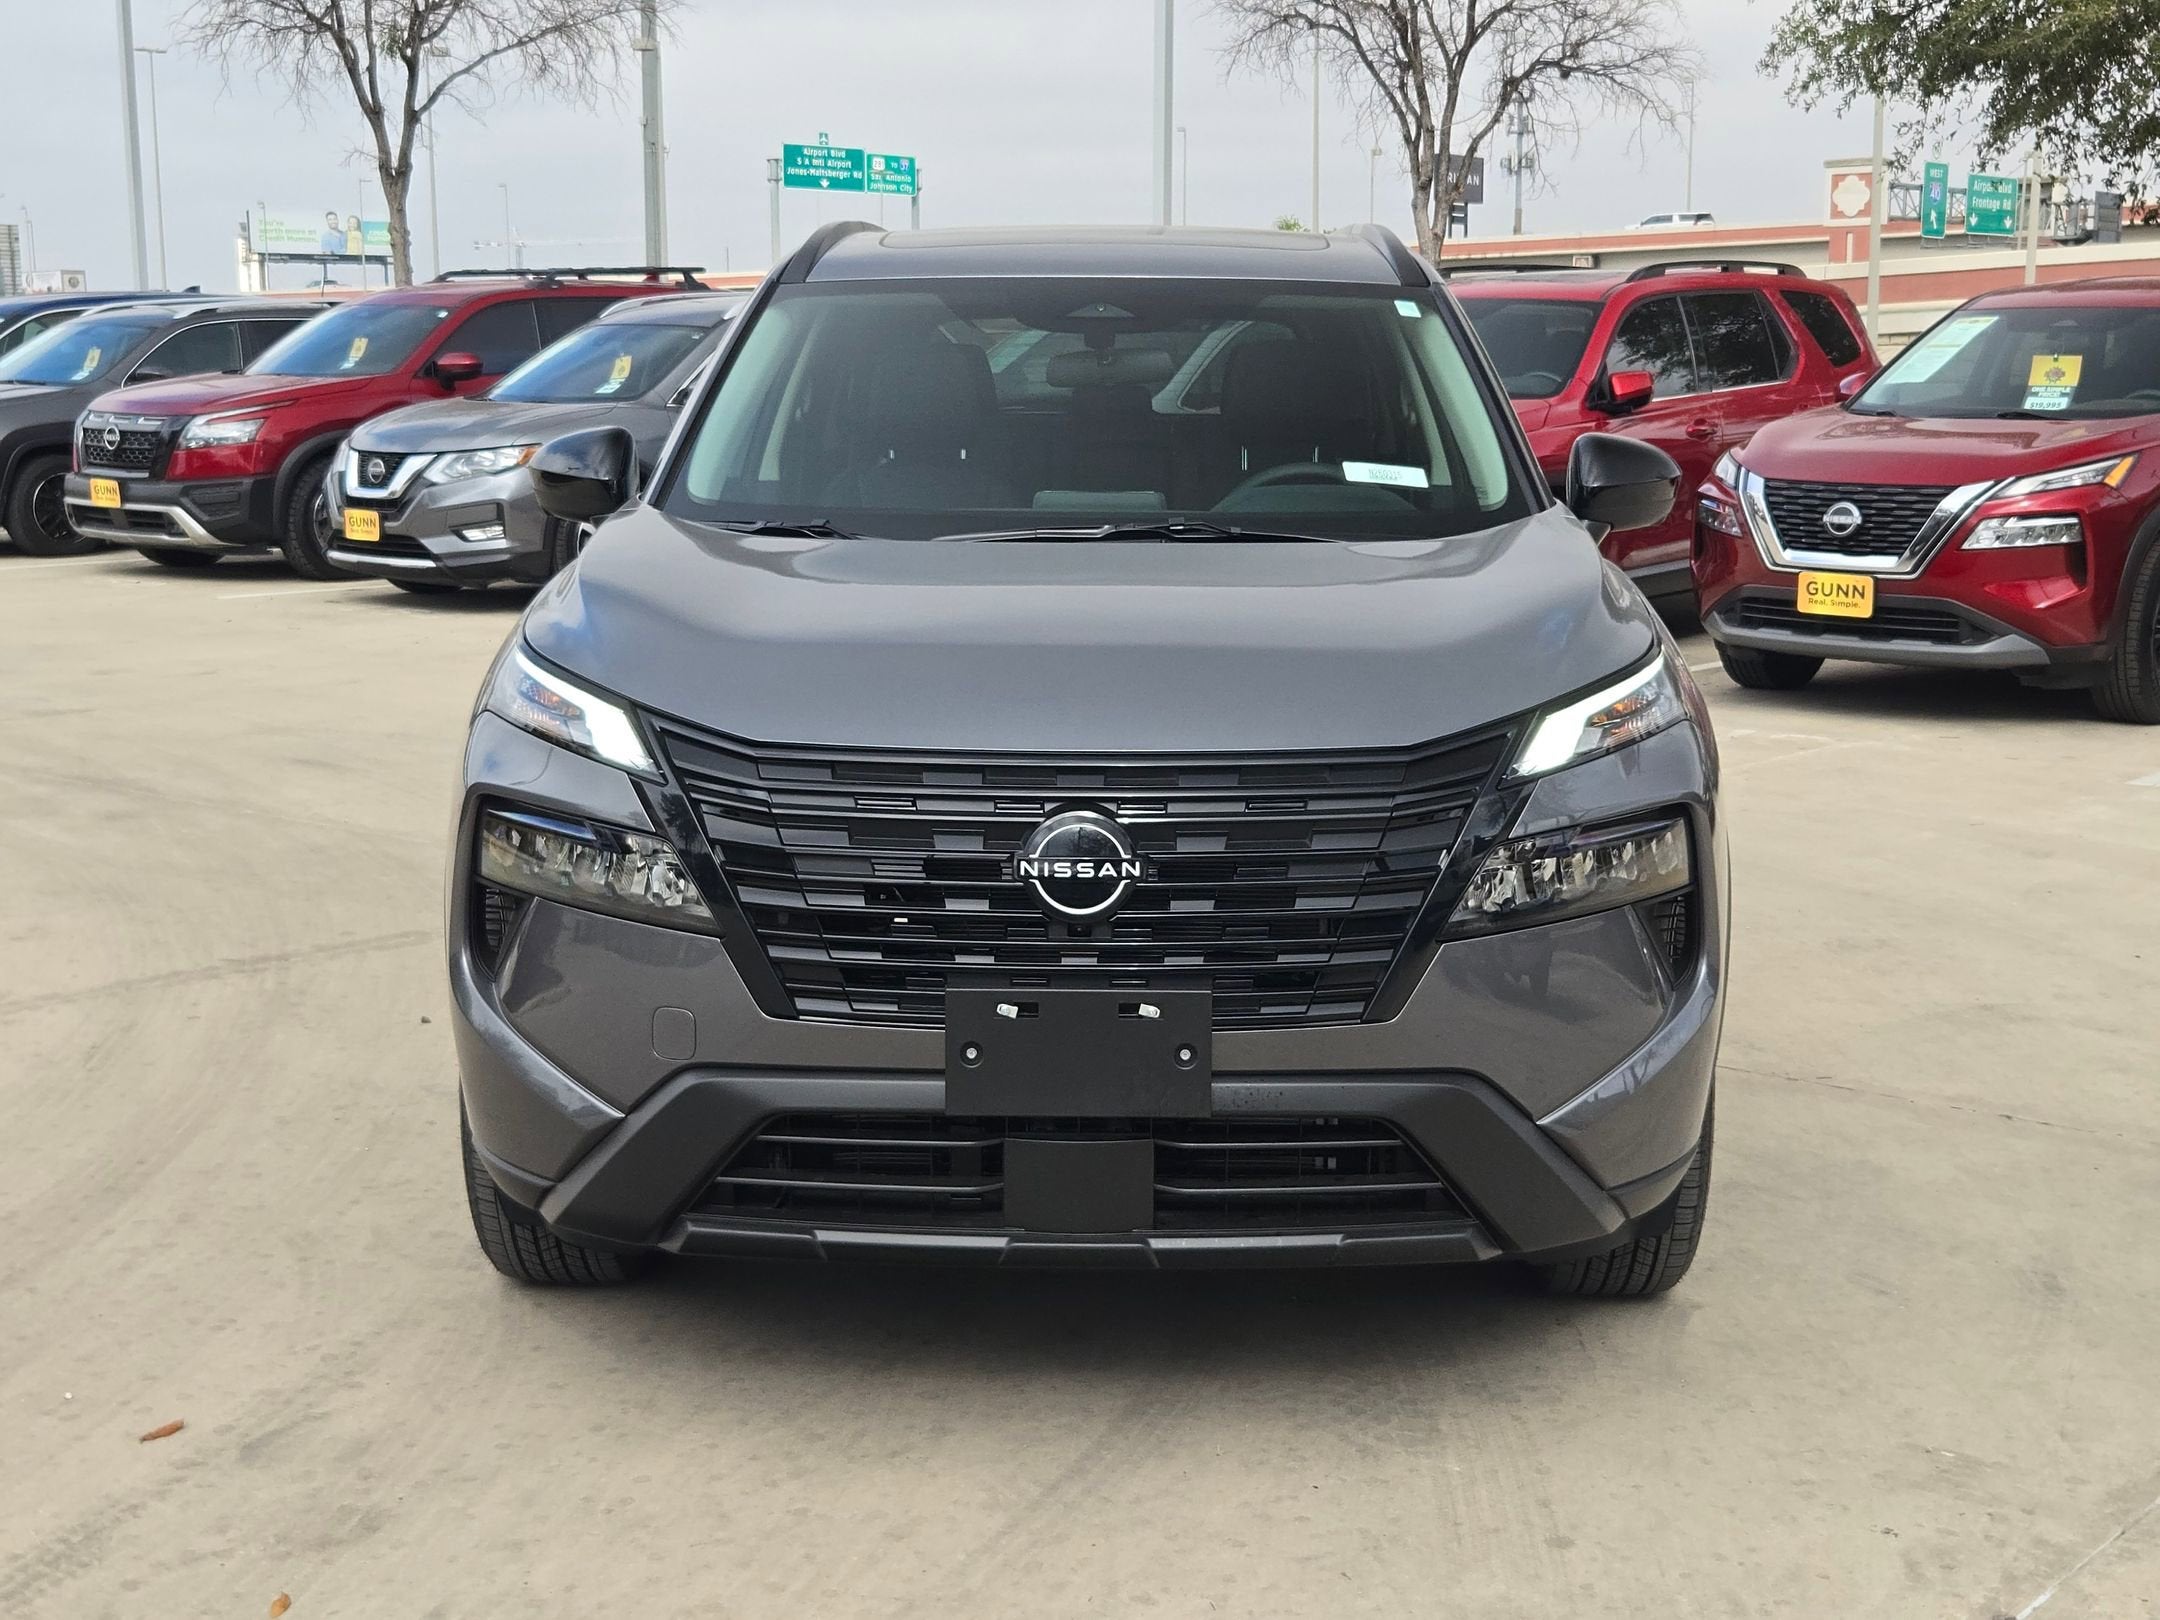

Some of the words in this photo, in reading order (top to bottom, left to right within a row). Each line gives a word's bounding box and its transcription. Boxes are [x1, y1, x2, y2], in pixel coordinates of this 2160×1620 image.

[803, 148, 828, 158] Airport
[830, 149, 846, 158] Blvd
[796, 157, 802, 165] S
[804, 158, 810, 166] A
[827, 159, 852, 169] Airport
[787, 167, 851, 179] Jones-Maltsberger
[853, 170, 863, 179] Rd
[885, 173, 912, 183] Antonio
[1447, 172, 1480, 186] RIAN
[1929, 168, 1944, 178] WEST
[899, 183, 913, 194] City
[1972, 196, 2001, 211] Frontage
[2002, 198, 2012, 211] Rd
[94, 485, 118, 497] GUNN
[348, 516, 376, 528] GUNN
[1806, 580, 1866, 600] GUNN
[1808, 597, 1828, 606] Real.
[1830, 599, 1861, 609] Simple.
[1019, 860, 1141, 878] NISSAN
